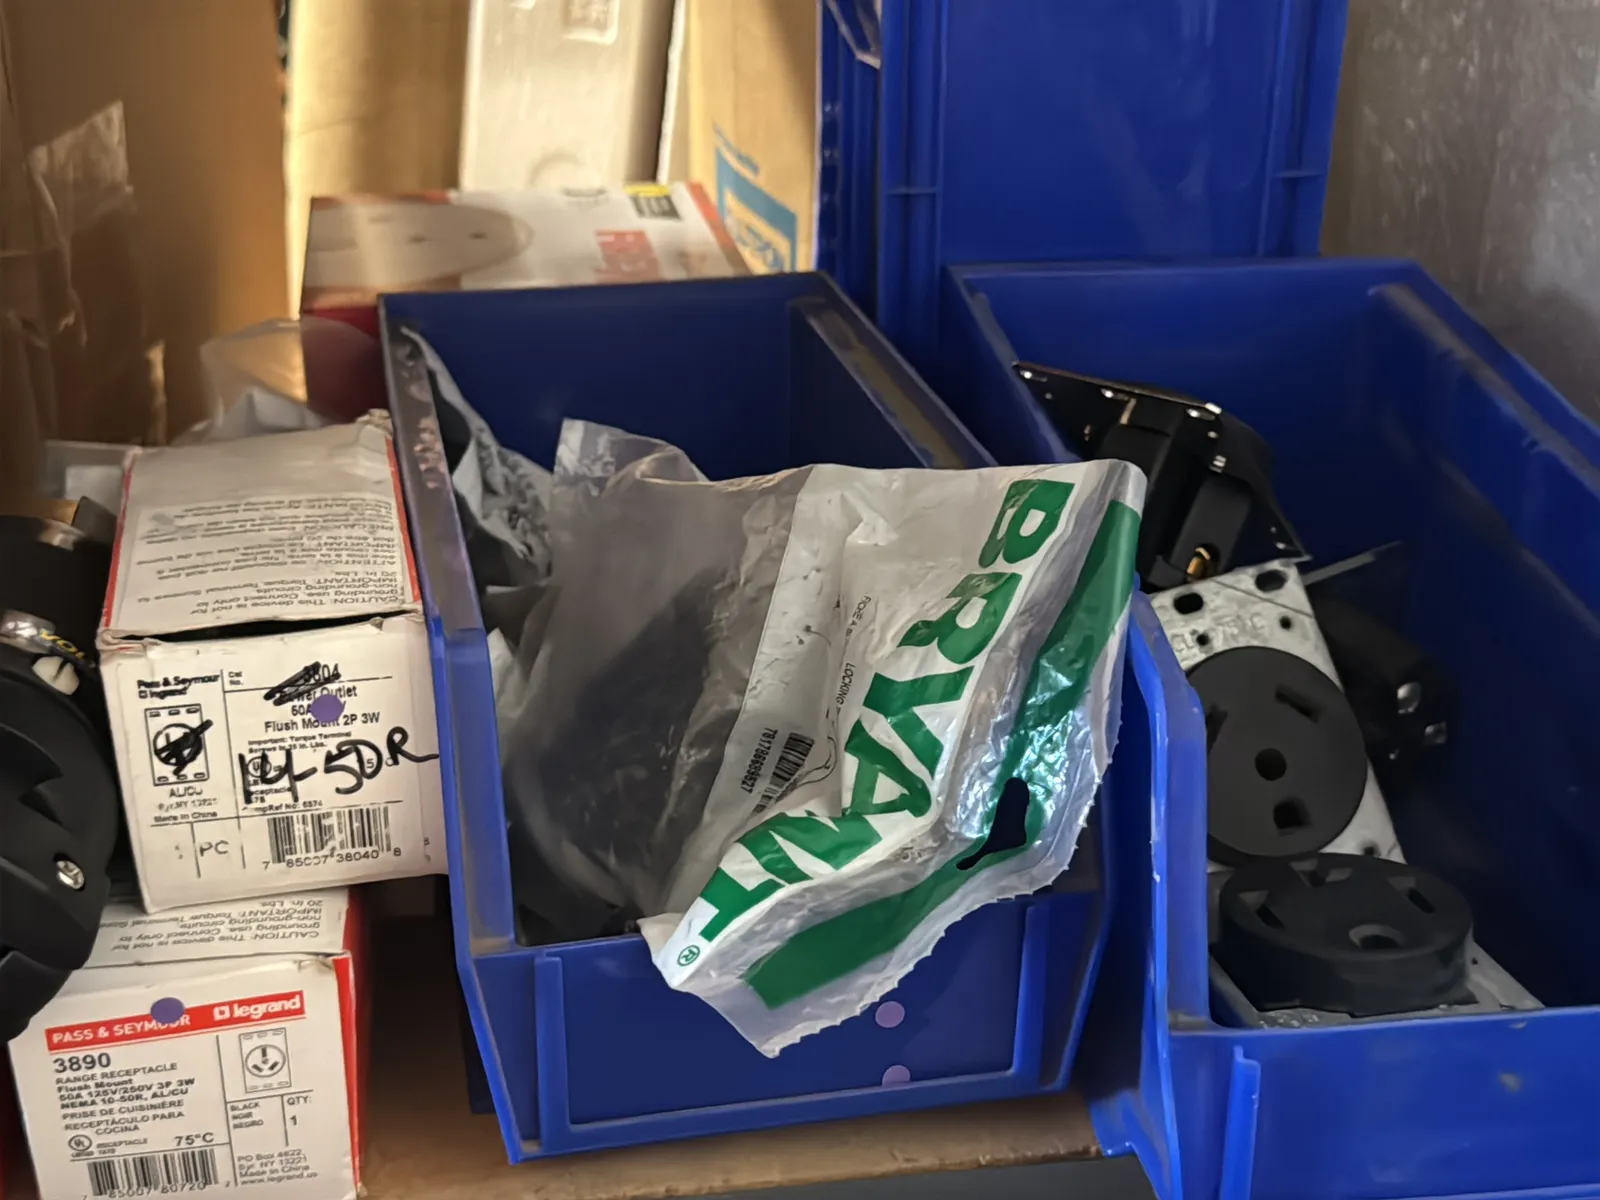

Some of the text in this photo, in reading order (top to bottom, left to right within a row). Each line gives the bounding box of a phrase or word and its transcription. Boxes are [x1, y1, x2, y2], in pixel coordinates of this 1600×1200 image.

[305, 582, 398, 591] non-grounding
[334, 588, 399, 597] grounding
[244, 592, 299, 602] Connect
[173, 674, 220, 688] Seymour
[836, 662, 856, 705] LOCKING
[699, 478, 1075, 942] BRYANT
[264, 719, 298, 733] Flush
[343, 714, 357, 726] 2P
[361, 711, 380, 724] 3W
[289, 733, 316, 743] Torque
[318, 730, 352, 740] Terminal
[191, 811, 218, 820] China
[199, 840, 229, 857] PC
[336, 849, 380, 863] 38040
[393, 846, 402, 857] 8
[306, 899, 323, 907] 20
[228, 915, 321, 925] non-grounding
[255, 922, 320, 931] grounding
[167, 928, 221, 938] Connect
[217, 934, 245, 942] This
[52, 1028, 93, 1044] PASS
[98, 1025, 109, 1039] &
[232, 995, 301, 1019] legrand
[53, 1052, 111, 1074] 3890
[55, 1063, 178, 1085] RANGE RECEPTACLE
[57, 1078, 134, 1093] Flush Mount
[157, 1081, 173, 1090] 3P
[176, 1078, 195, 1087] 3W
[60, 1100, 98, 1110] NEMA
[151, 1087, 189, 1099] AL/CU
[286, 1095, 312, 1106] QTY:
[230, 1102, 260, 1112] BLACK
[62, 1109, 97, 1120] PRISE
[100, 1107, 115, 1116] DE
[152, 1111, 185, 1121] PARA
[289, 1114, 298, 1126] 1
[95, 1124, 140, 1136] COCINA
[174, 1132, 215, 1147] 75°C
